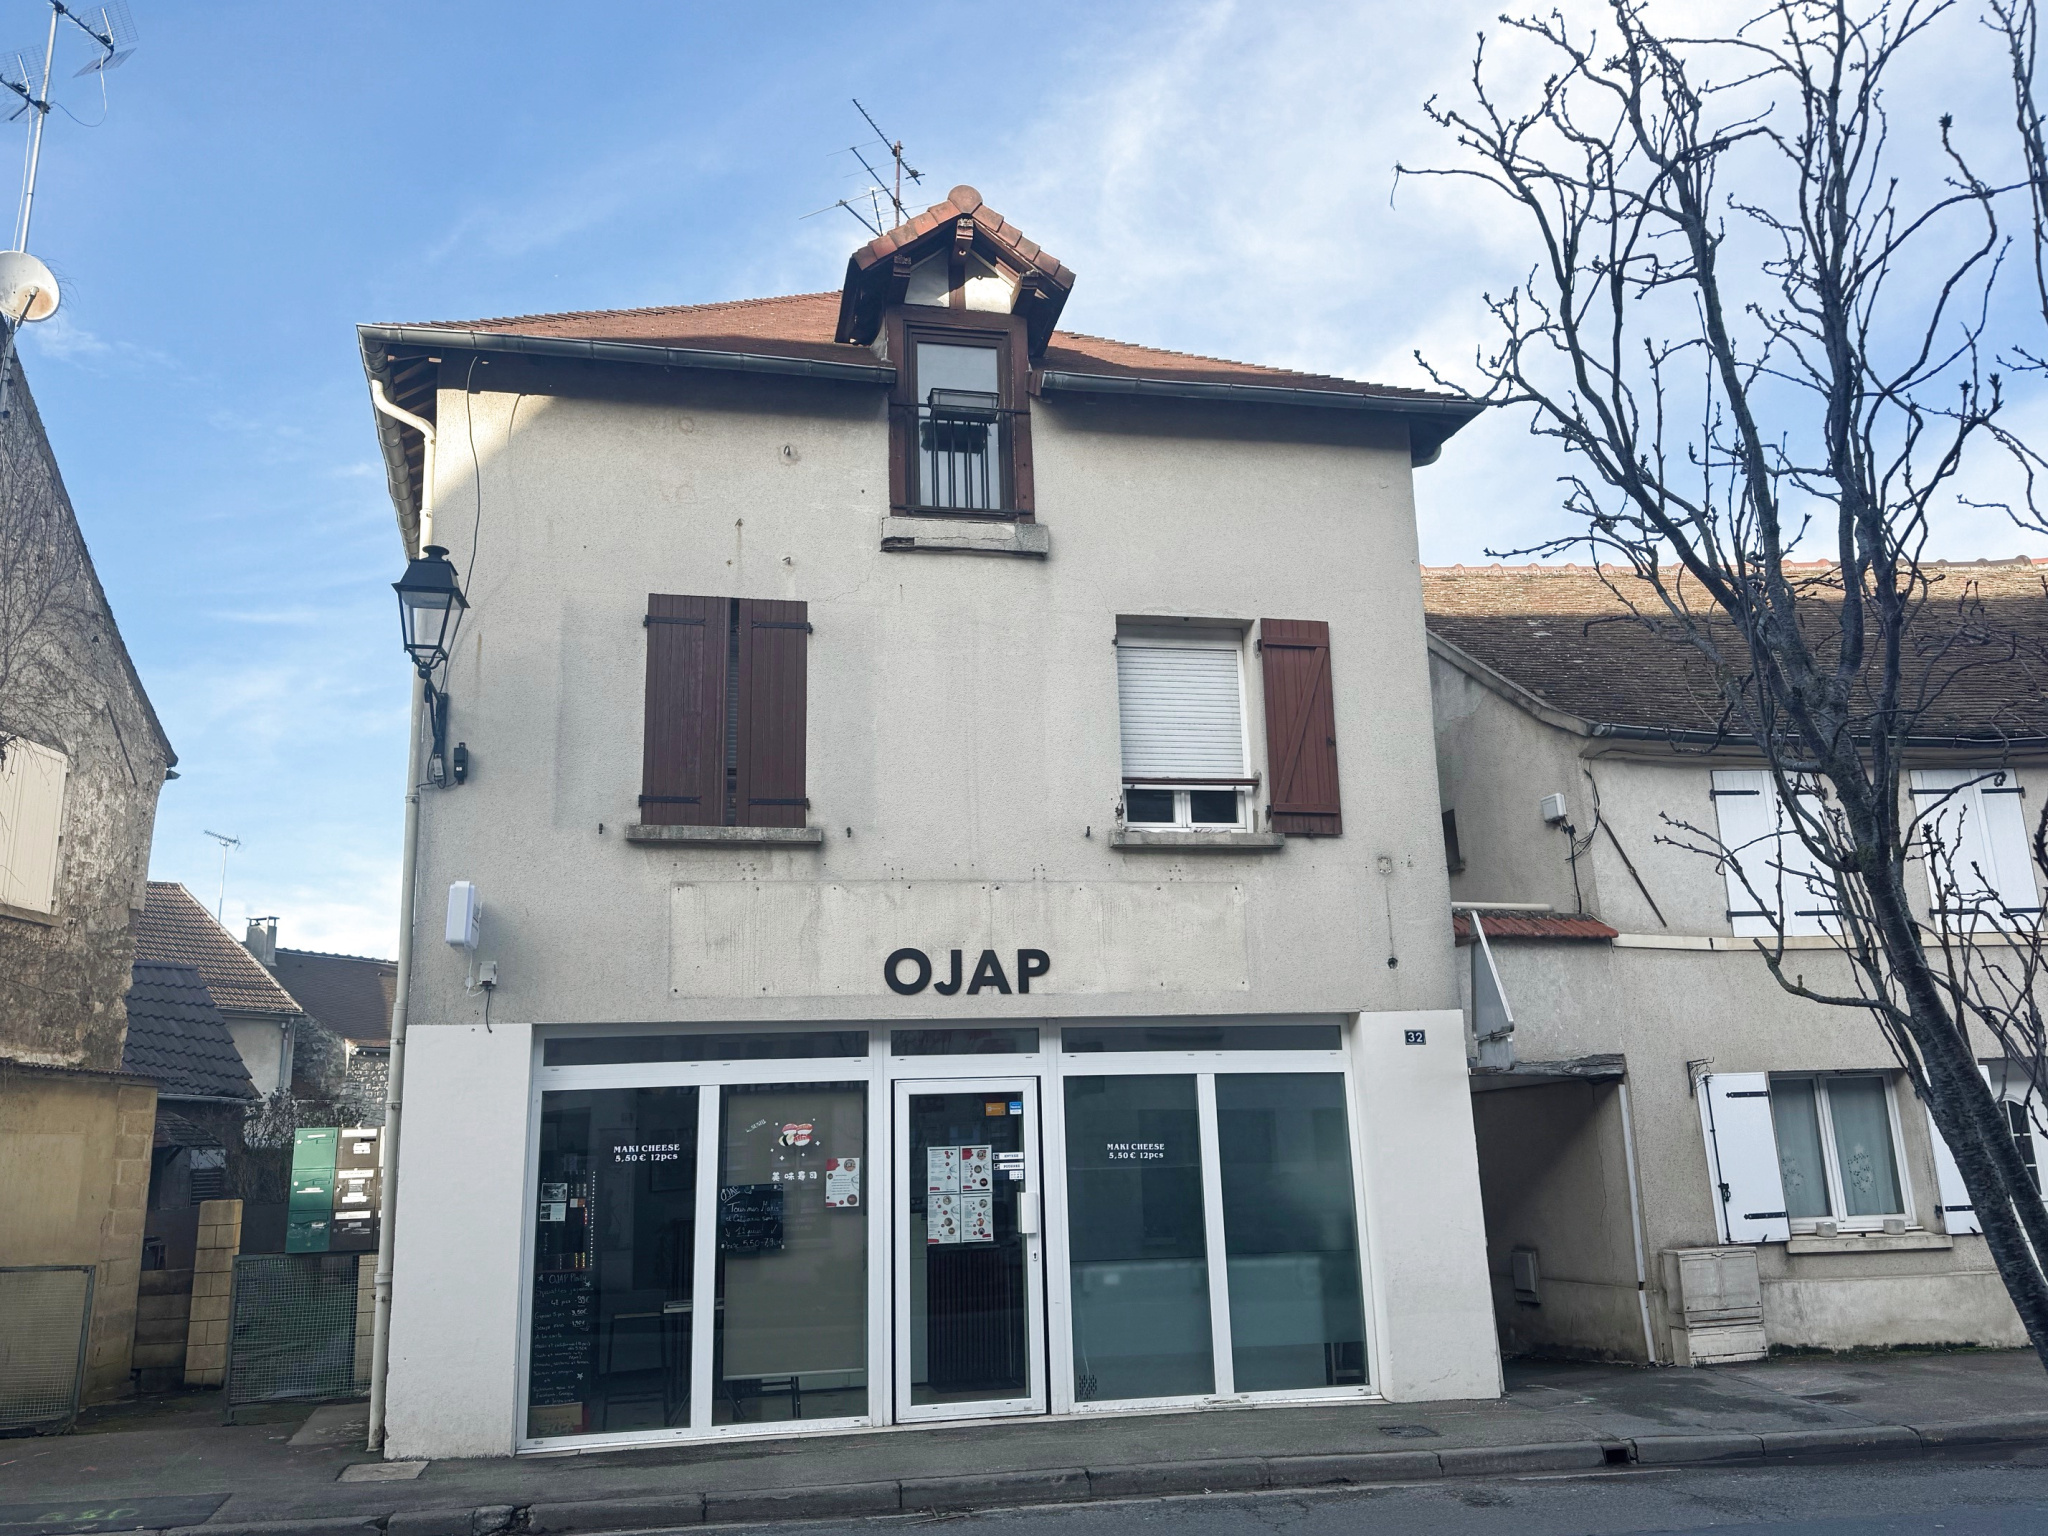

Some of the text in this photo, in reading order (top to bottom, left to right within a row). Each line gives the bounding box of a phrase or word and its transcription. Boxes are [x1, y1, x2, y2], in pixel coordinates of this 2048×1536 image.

[884, 948, 1050, 996] OJAP
[1407, 1032, 1423, 1043] 32
[613, 1144, 680, 1153] MAKI CHEESE
[650, 1153, 678, 1161] 12pcs
[1139, 1152, 1164, 1160] 12pcs
